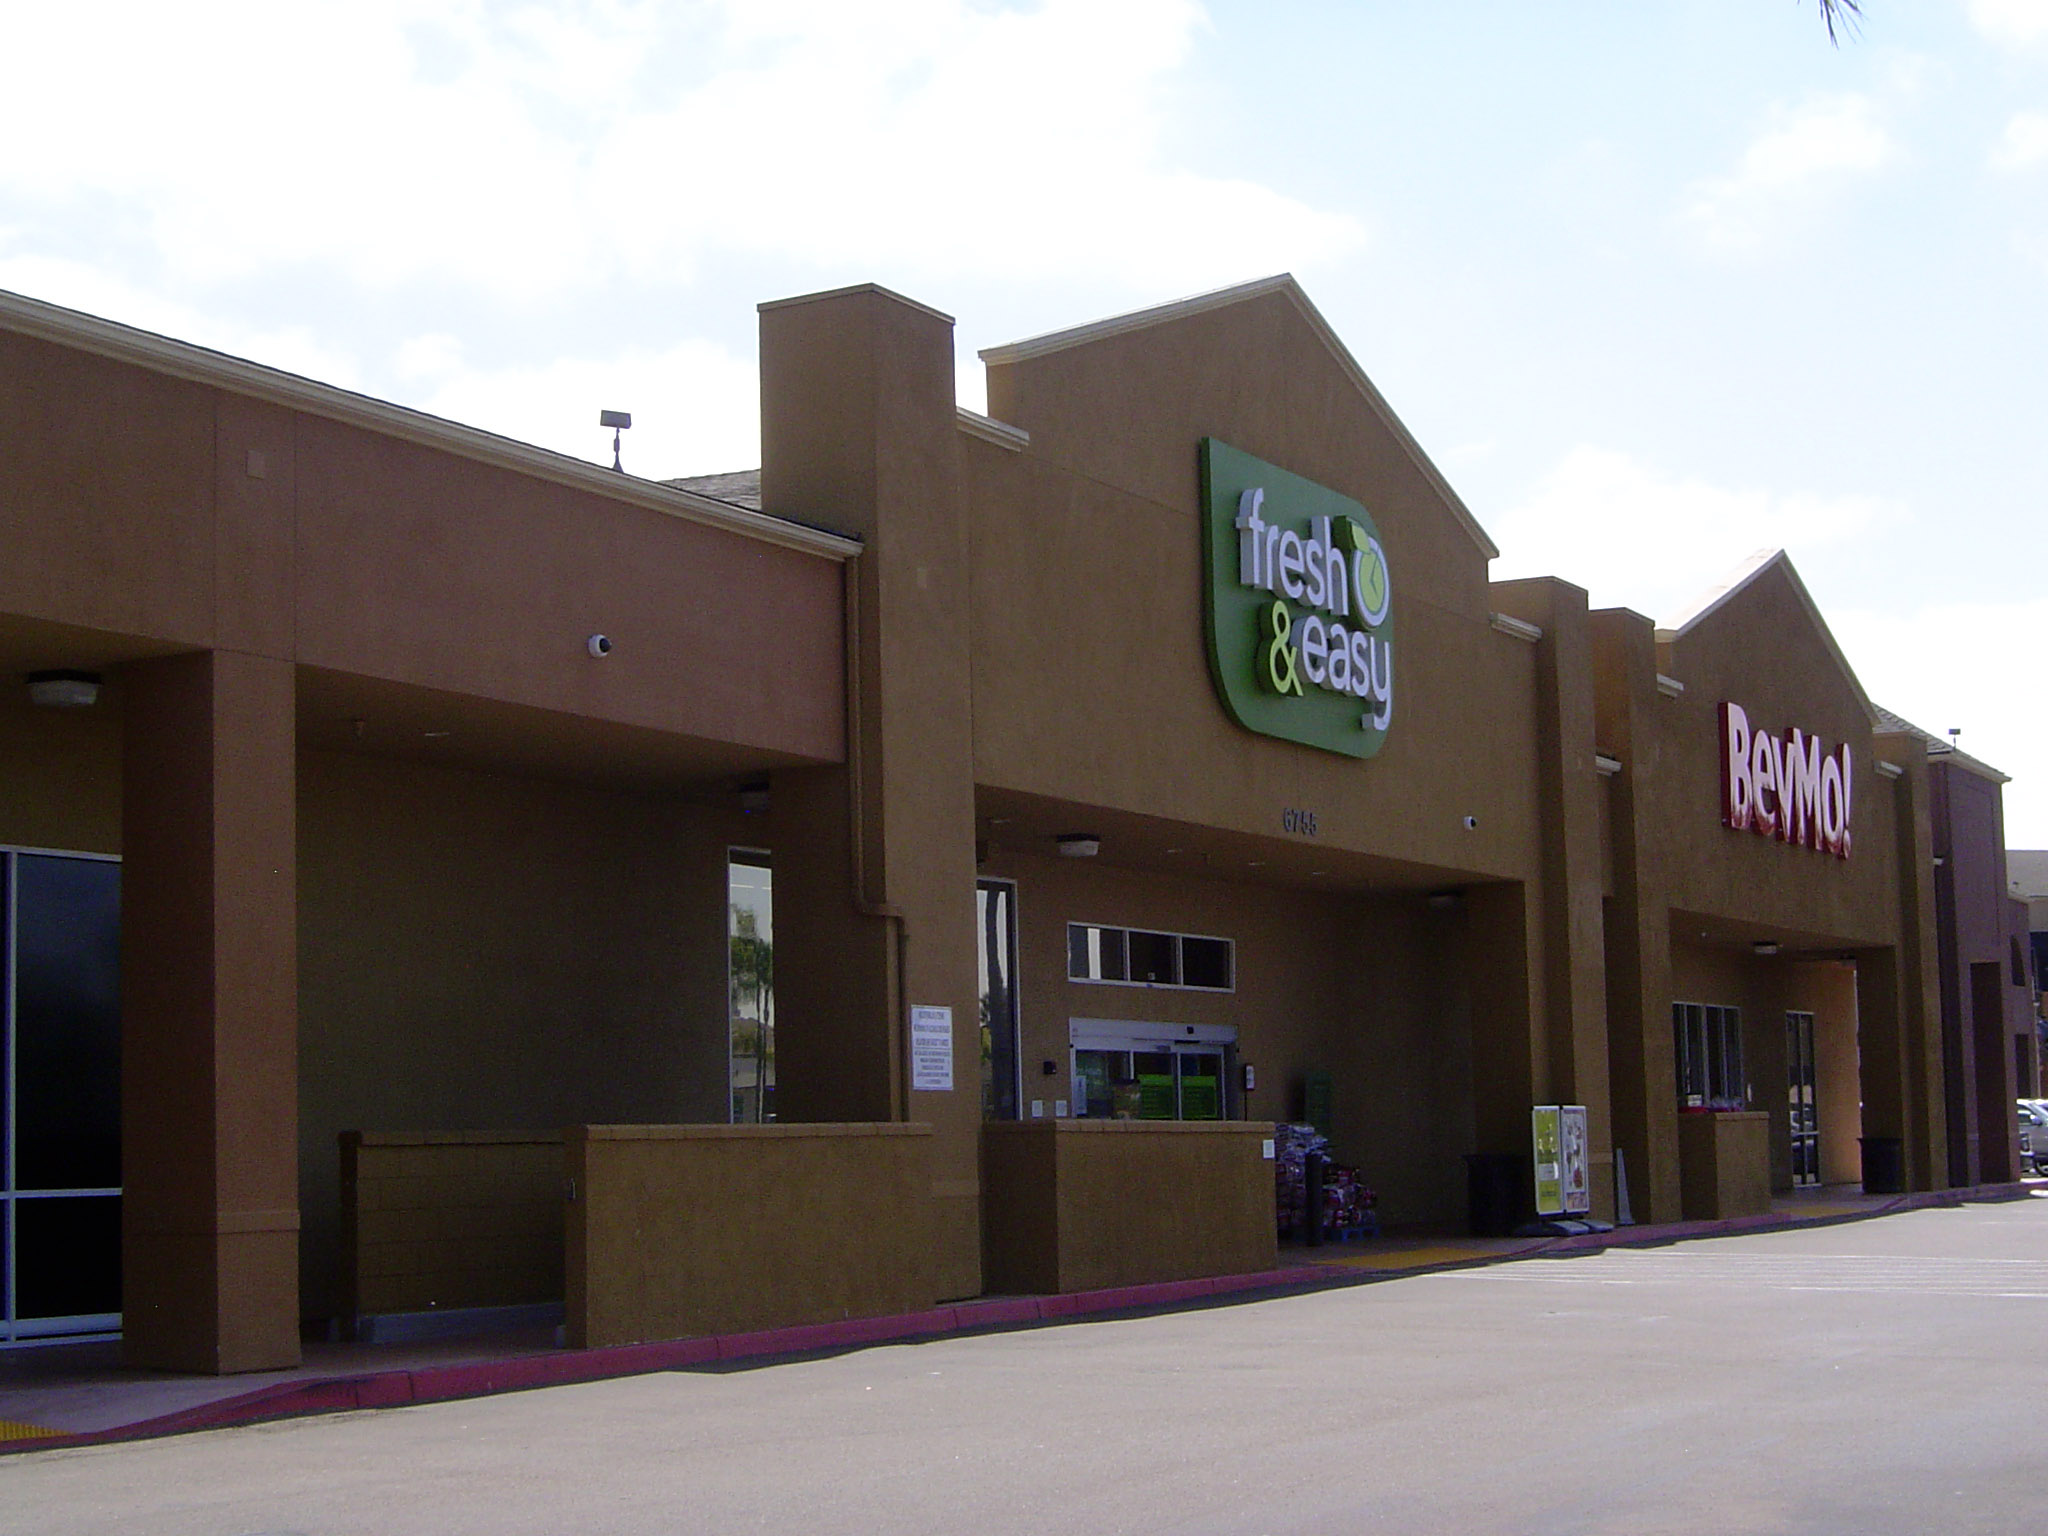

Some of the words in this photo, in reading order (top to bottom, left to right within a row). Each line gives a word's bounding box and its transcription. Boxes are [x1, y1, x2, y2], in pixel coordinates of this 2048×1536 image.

[1237, 487, 1349, 616] fresh
[1269, 600, 1303, 697] &
[1297, 614, 1392, 732] easy
[1723, 702, 1851, 859] BevMo!
